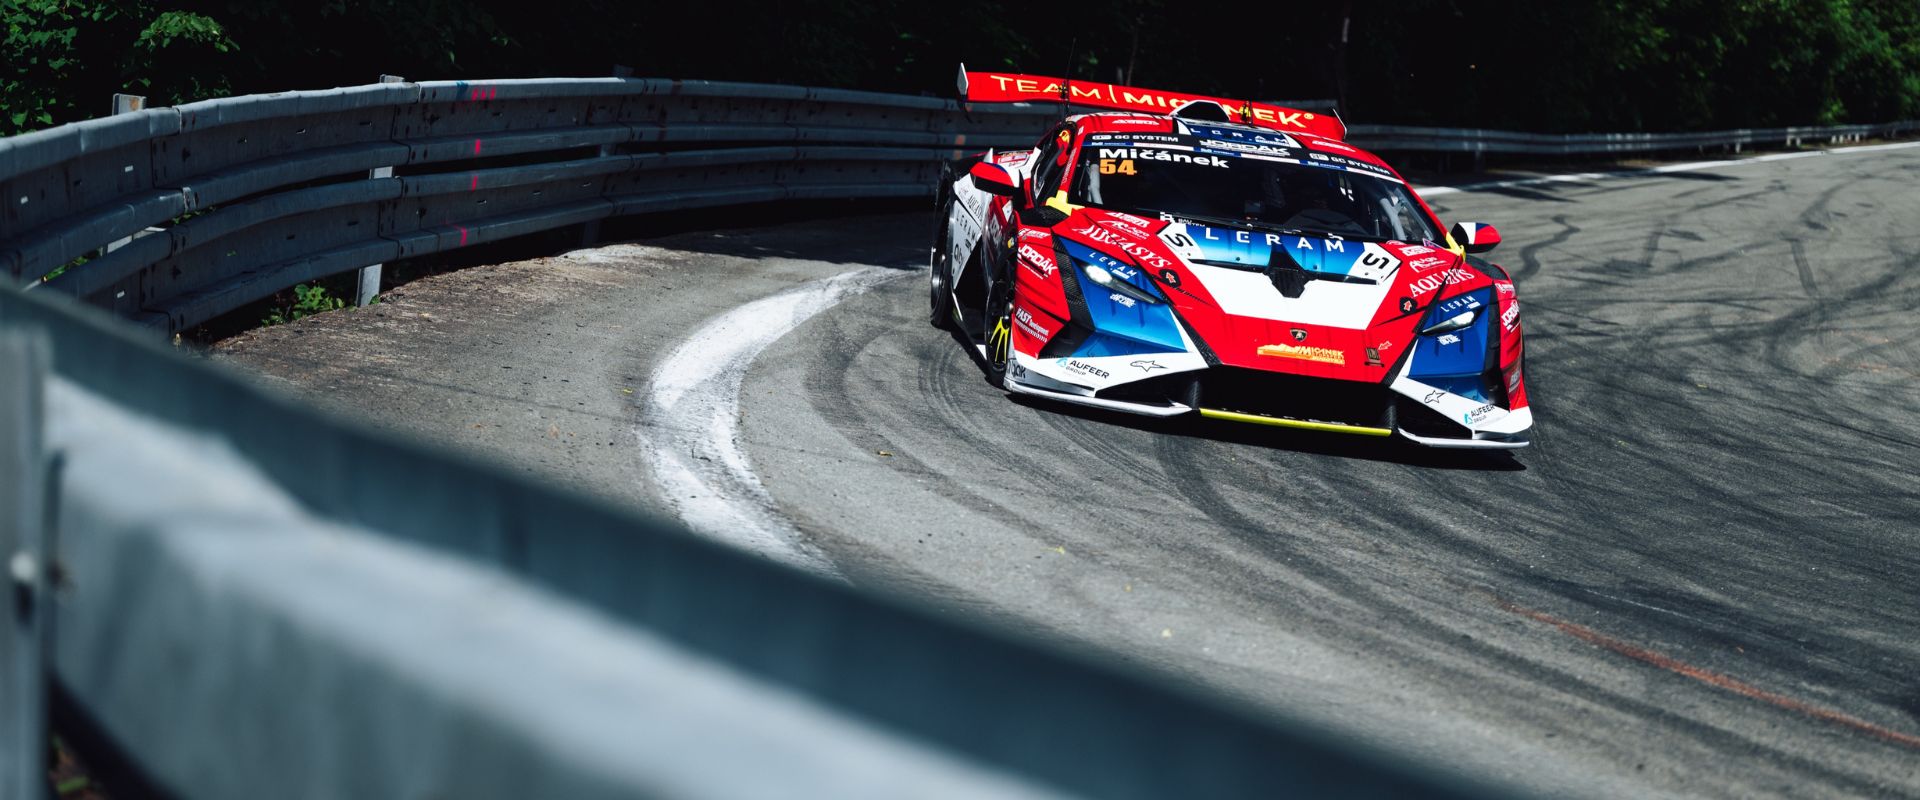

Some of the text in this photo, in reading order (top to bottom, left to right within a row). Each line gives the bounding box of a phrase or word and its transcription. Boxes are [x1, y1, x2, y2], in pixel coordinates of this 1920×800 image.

[990, 75, 1101, 100] TEAM
[1099, 148, 1230, 169] Mičánek
[1099, 159, 1138, 176] 54
[1205, 227, 1345, 253] LERAM
[1018, 243, 1058, 275] JORDÁK
[1089, 252, 1138, 277] LERAM
[1440, 295, 1477, 313] LERAM
[1015, 307, 1033, 324] FAST
[1070, 360, 1110, 379] AUFEER
[1470, 403, 1496, 418] AUFEER
